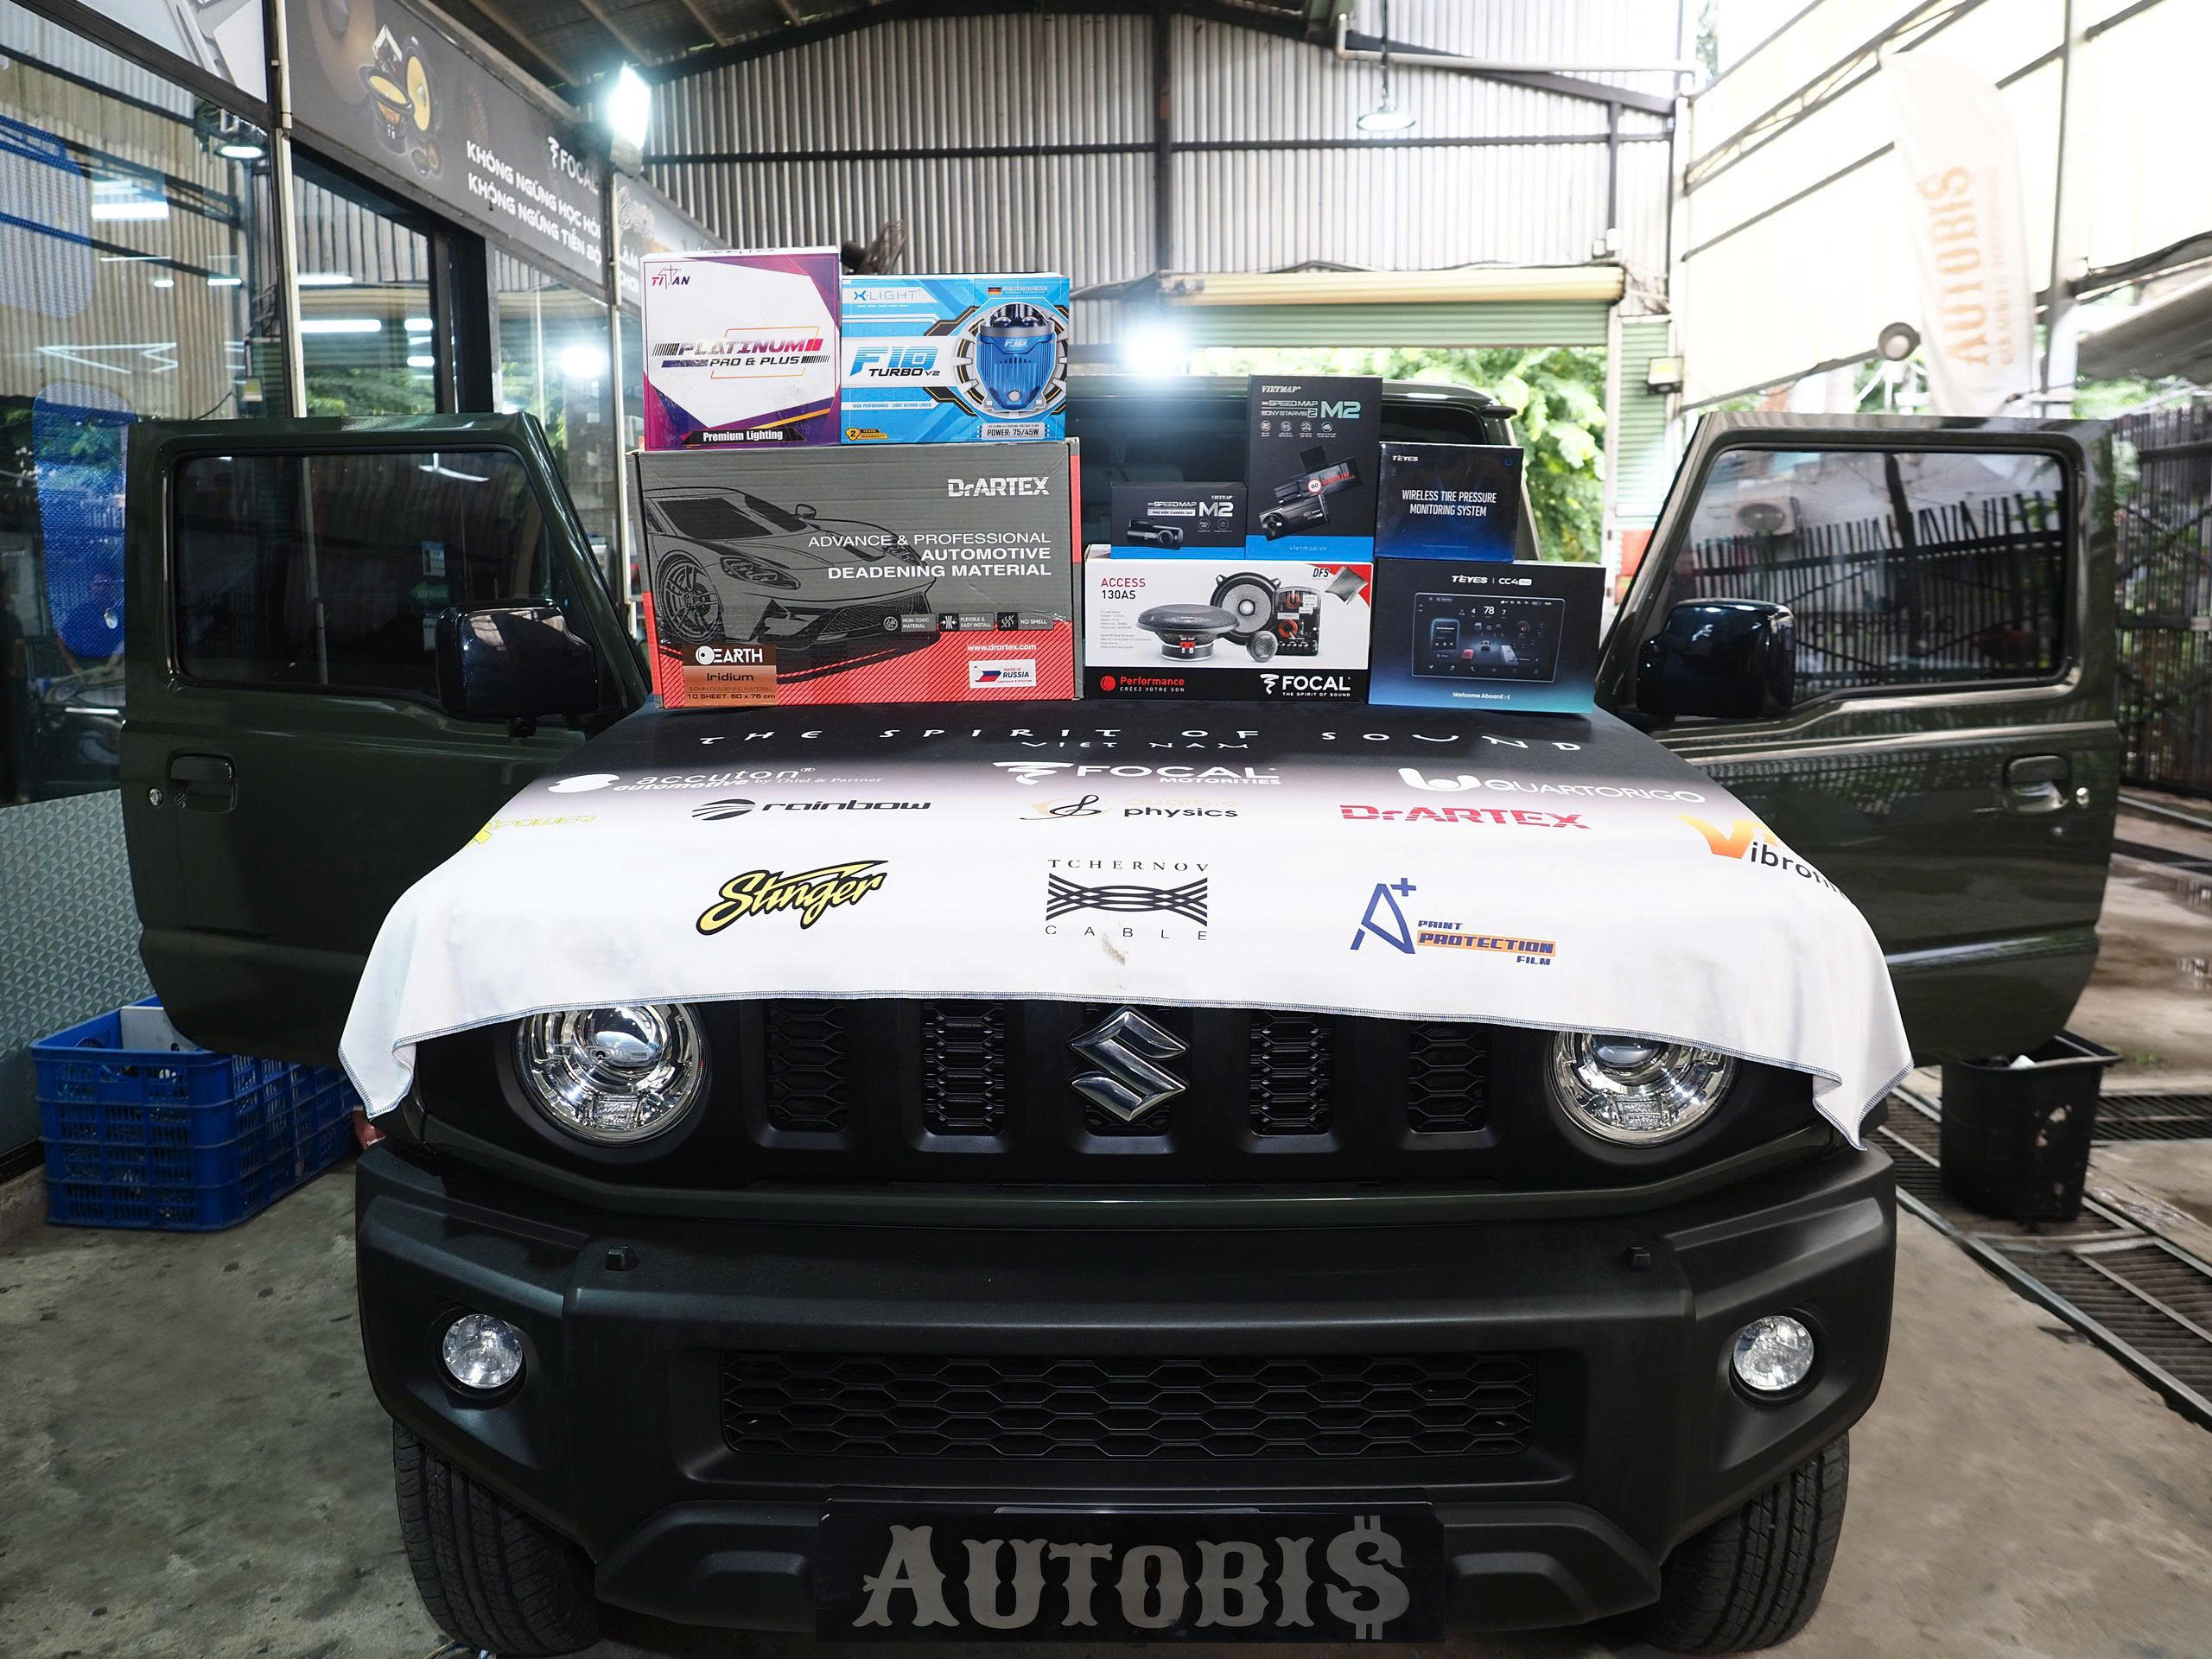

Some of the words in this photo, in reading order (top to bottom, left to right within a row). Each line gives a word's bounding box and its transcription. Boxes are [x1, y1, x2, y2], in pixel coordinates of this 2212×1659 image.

[560, 149, 599, 196] FOCAL
[678, 338, 804, 356] PLATINUM
[709, 358, 741, 367] PRO
[760, 356, 801, 365] PLUS
[849, 346, 938, 377] F10
[868, 368, 923, 377] TURBO
[1321, 400, 1362, 419] M2
[703, 430, 744, 442] Premium
[747, 429, 784, 442] Lighting
[1013, 428, 1039, 436] 75/45W
[947, 476, 1050, 498] DrARTEX
[1402, 489, 1439, 502] WIRELESS
[1440, 490, 1457, 502] TIRE
[1458, 491, 1497, 504] PRESSURE
[1198, 501, 1234, 518] M2
[1409, 503, 1455, 516] MONITORING
[1457, 505, 1487, 517] SYSTEM
[808, 534, 892, 548] ADVANCE
[897, 534, 909, 546] &
[914, 531, 1052, 546] PROFESSIONAL
[920, 548, 1052, 562] AUTOMOTIVE
[828, 564, 946, 580] DEADENING
[951, 563, 1052, 577] MATERIAL
[1313, 568, 1330, 578] DFS
[1101, 577, 1147, 588] ACCESS
[1101, 589, 1136, 600] 130AS
[1483, 606, 1495, 615] 78
[967, 643, 1037, 652] www.drartex.com
[706, 672, 754, 681] Iridium
[1120, 677, 1185, 686] Performance
[1282, 675, 1351, 691] FOCAL
[699, 730, 823, 745] THE
[879, 728, 1122, 740] SPIRIT
[1180, 728, 1260, 740] OF
[1321, 731, 1582, 751] SOUND
[636, 769, 801, 785] accuton
[1077, 765, 1281, 779] FOCAL
[613, 779, 750, 791] automotive
[1159, 777, 1281, 785] MOTORITIES
[1484, 779, 1707, 803] QUARTORIGO
[761, 800, 931, 811] rainbow
[1123, 806, 1238, 817] physics
[1339, 804, 1592, 830] DrARTEX
[1047, 859, 1209, 872] TCHERNOV
[696, 860, 889, 936] Stinger
[1045, 925, 1208, 941] CABLE
[1418, 931, 1554, 955] PROTECTION
[1516, 955, 1552, 966] FILM
